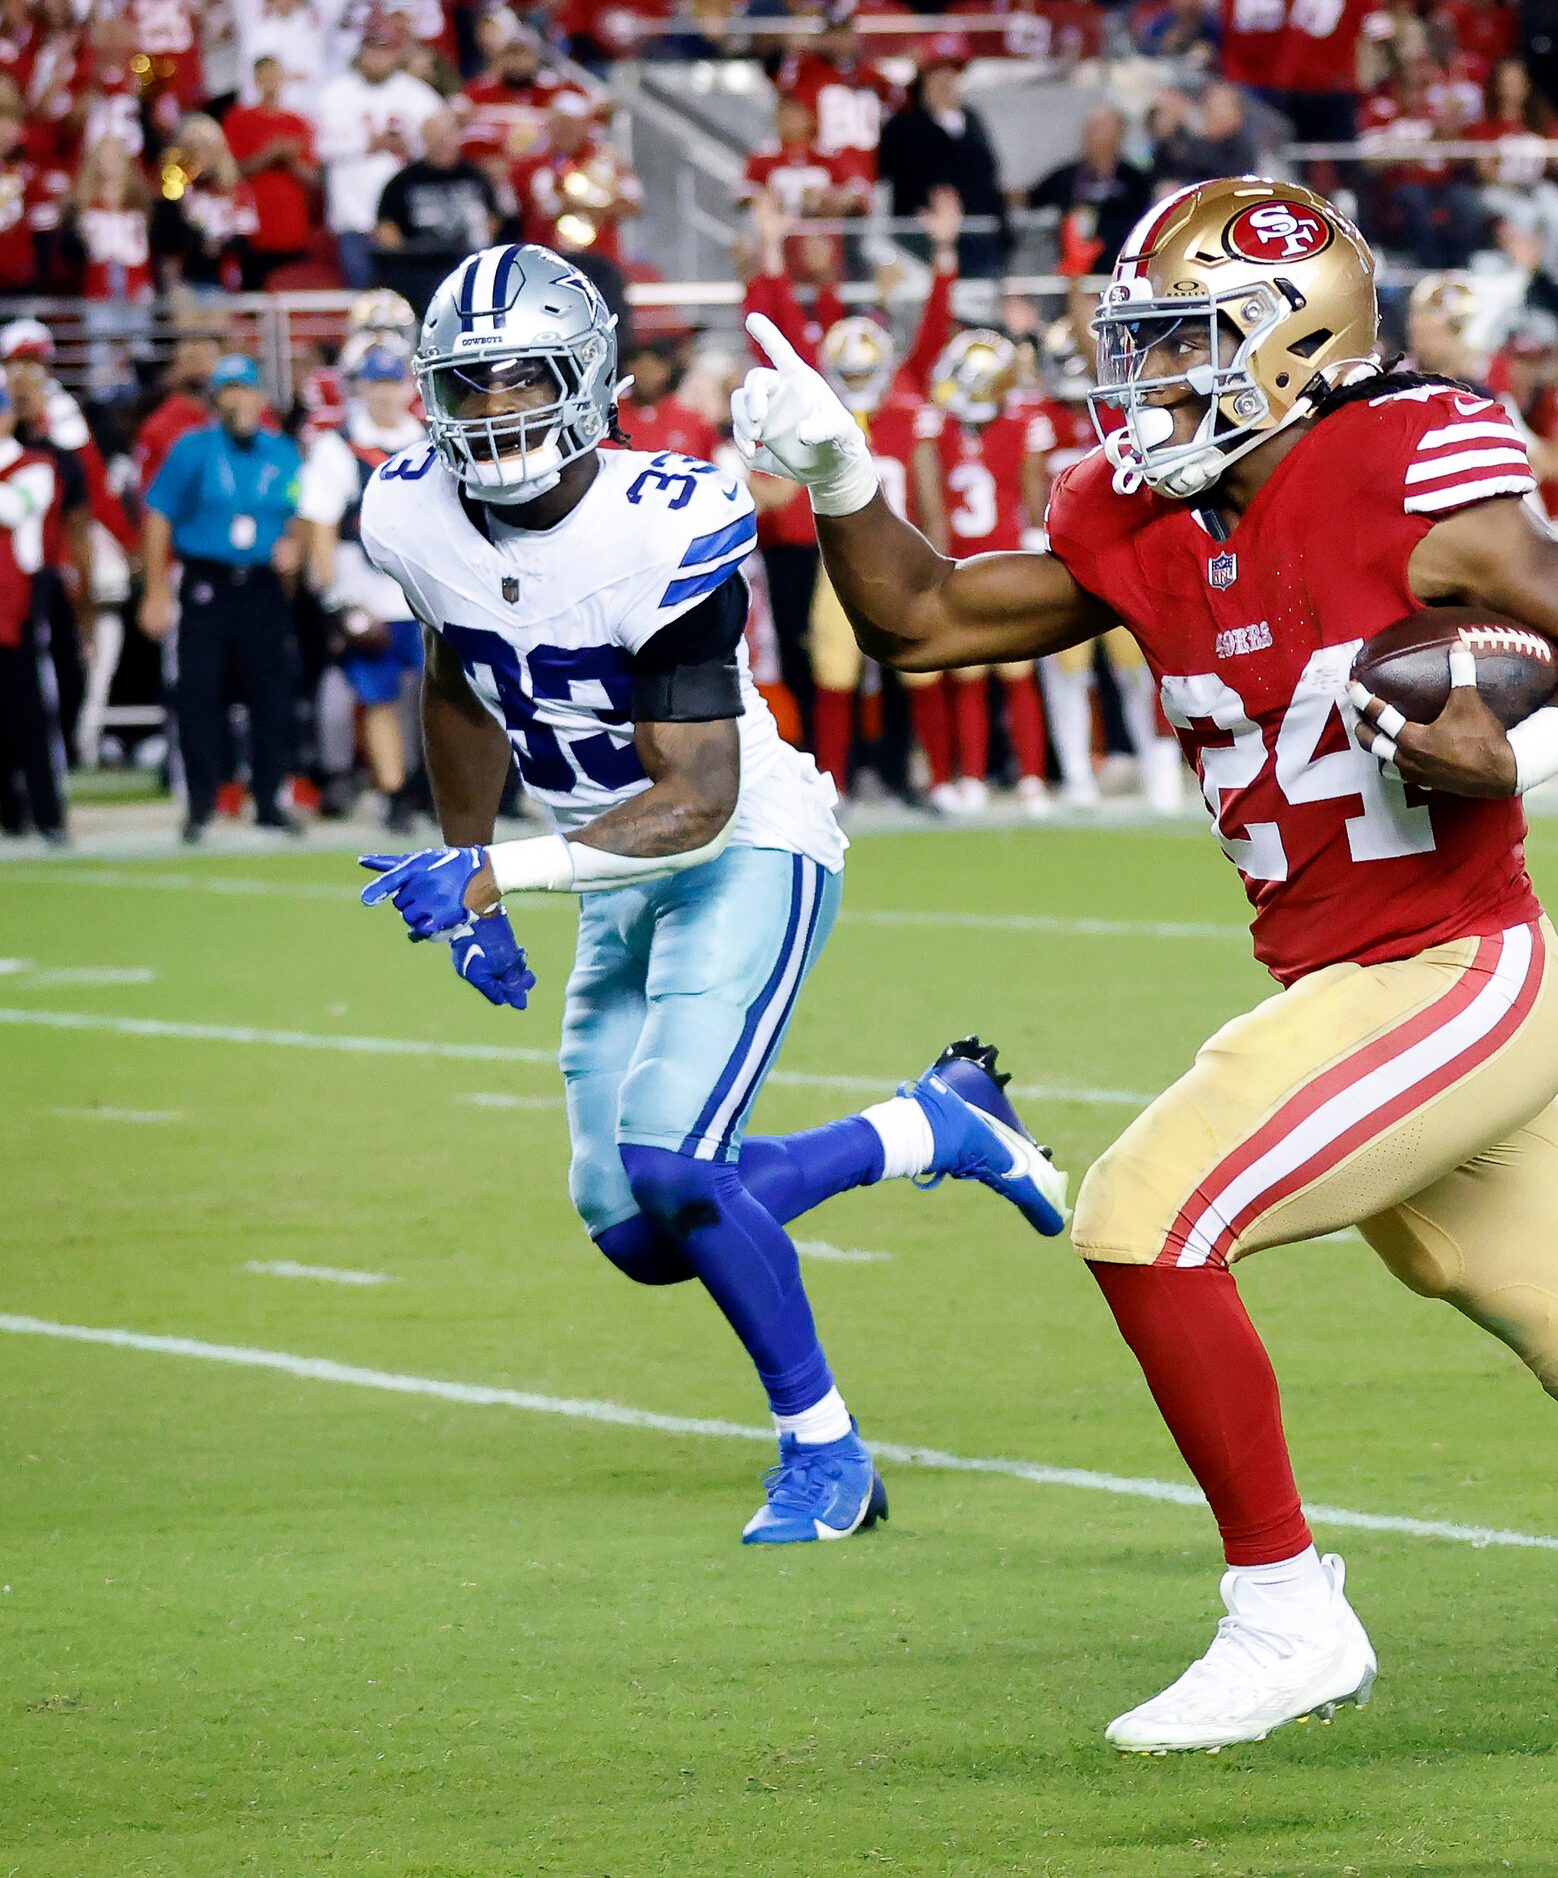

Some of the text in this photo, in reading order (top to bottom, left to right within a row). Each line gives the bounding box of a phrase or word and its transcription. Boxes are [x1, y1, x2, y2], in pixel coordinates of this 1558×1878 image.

[462, 336, 503, 346] COWBOYS
[949, 462, 997, 538] 3
[443, 621, 649, 793] 33
[1160, 637, 1437, 882] 24
